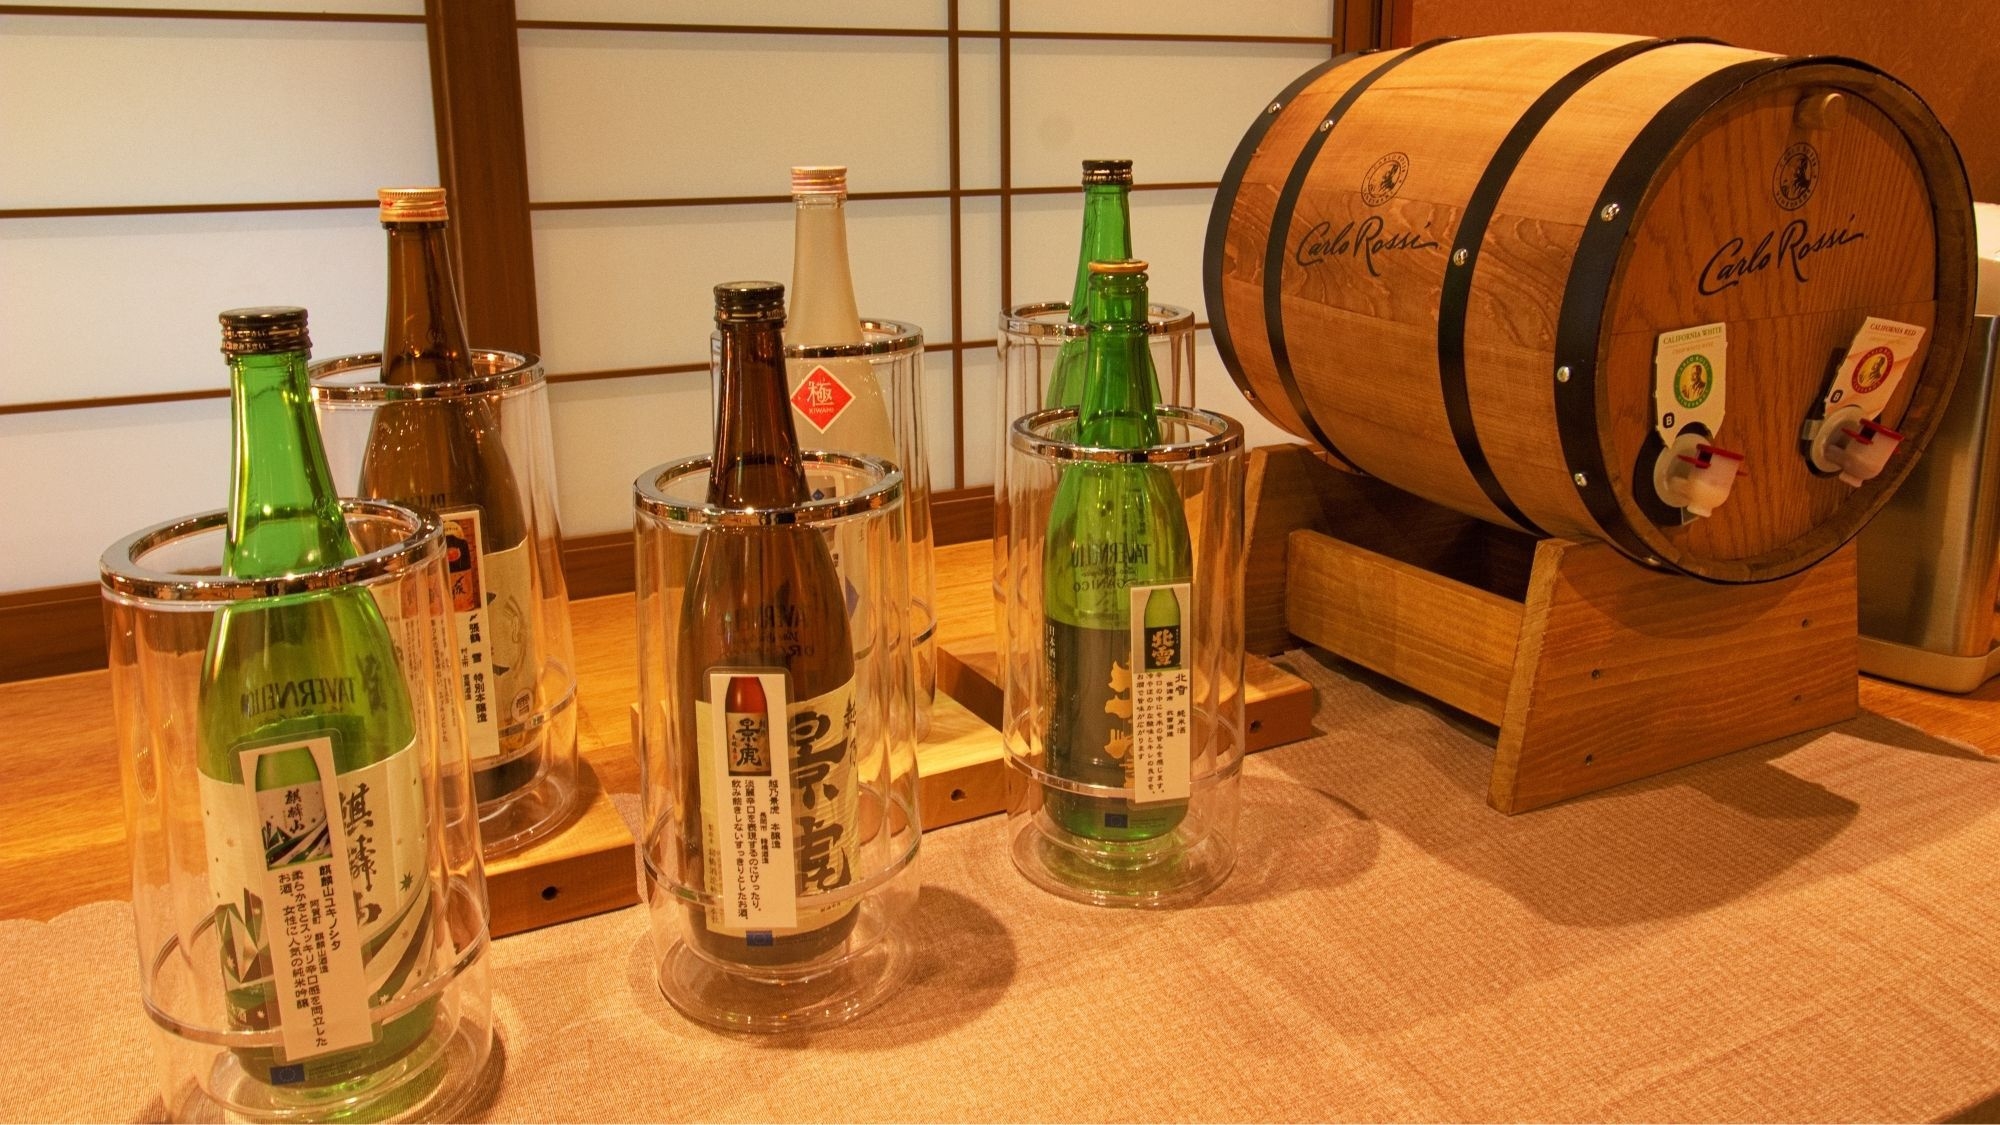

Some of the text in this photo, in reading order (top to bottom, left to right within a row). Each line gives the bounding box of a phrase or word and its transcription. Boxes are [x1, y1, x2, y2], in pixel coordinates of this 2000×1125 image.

[1296, 215, 1439, 277] Carlo Rossi
[1697, 213, 1865, 296] Carlo Rossi
[1663, 326, 1722, 345] CALIFORNIA WHITE
[1870, 323, 1917, 337] CALIFORNIA RED
[807, 377, 835, 407] 極
[1665, 415, 1673, 426] B
[473, 672, 487, 724] 特別本醸造
[1175, 673, 1188, 734] 北雪 純米酒
[735, 717, 763, 767] 景虎
[285, 788, 306, 834] 麒麟山
[768, 779, 781, 849] 越乃景虎 本醸造
[318, 864, 342, 951] 麒麟山ユキノシタ
[292, 869, 328, 1048] 柔らかさとスッキリ辛口感を両立した
[314, 932, 329, 974] 麒麟山酒造
